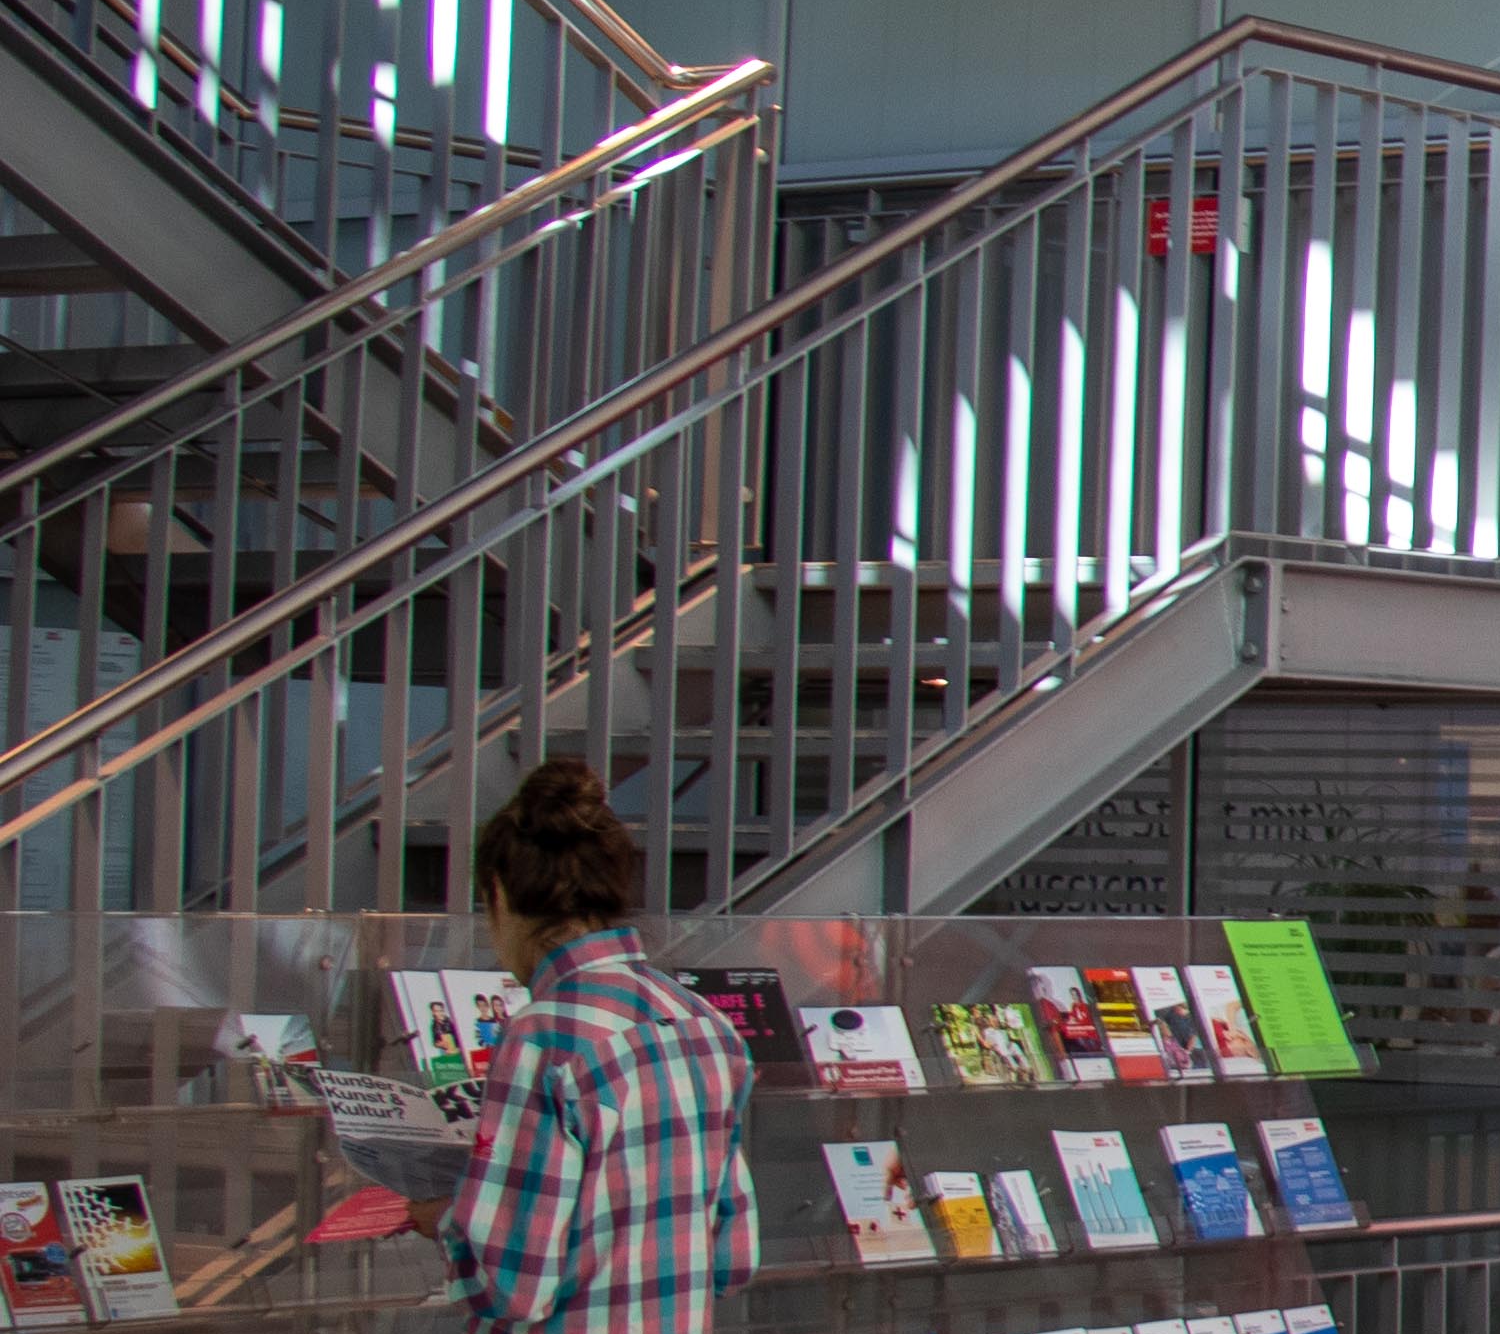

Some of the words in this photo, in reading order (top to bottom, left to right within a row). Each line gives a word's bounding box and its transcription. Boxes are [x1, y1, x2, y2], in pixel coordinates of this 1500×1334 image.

[318, 1072, 396, 1091] Hunger
[325, 1086, 386, 1104] Kunst
[330, 1101, 406, 1120] Kultur?
